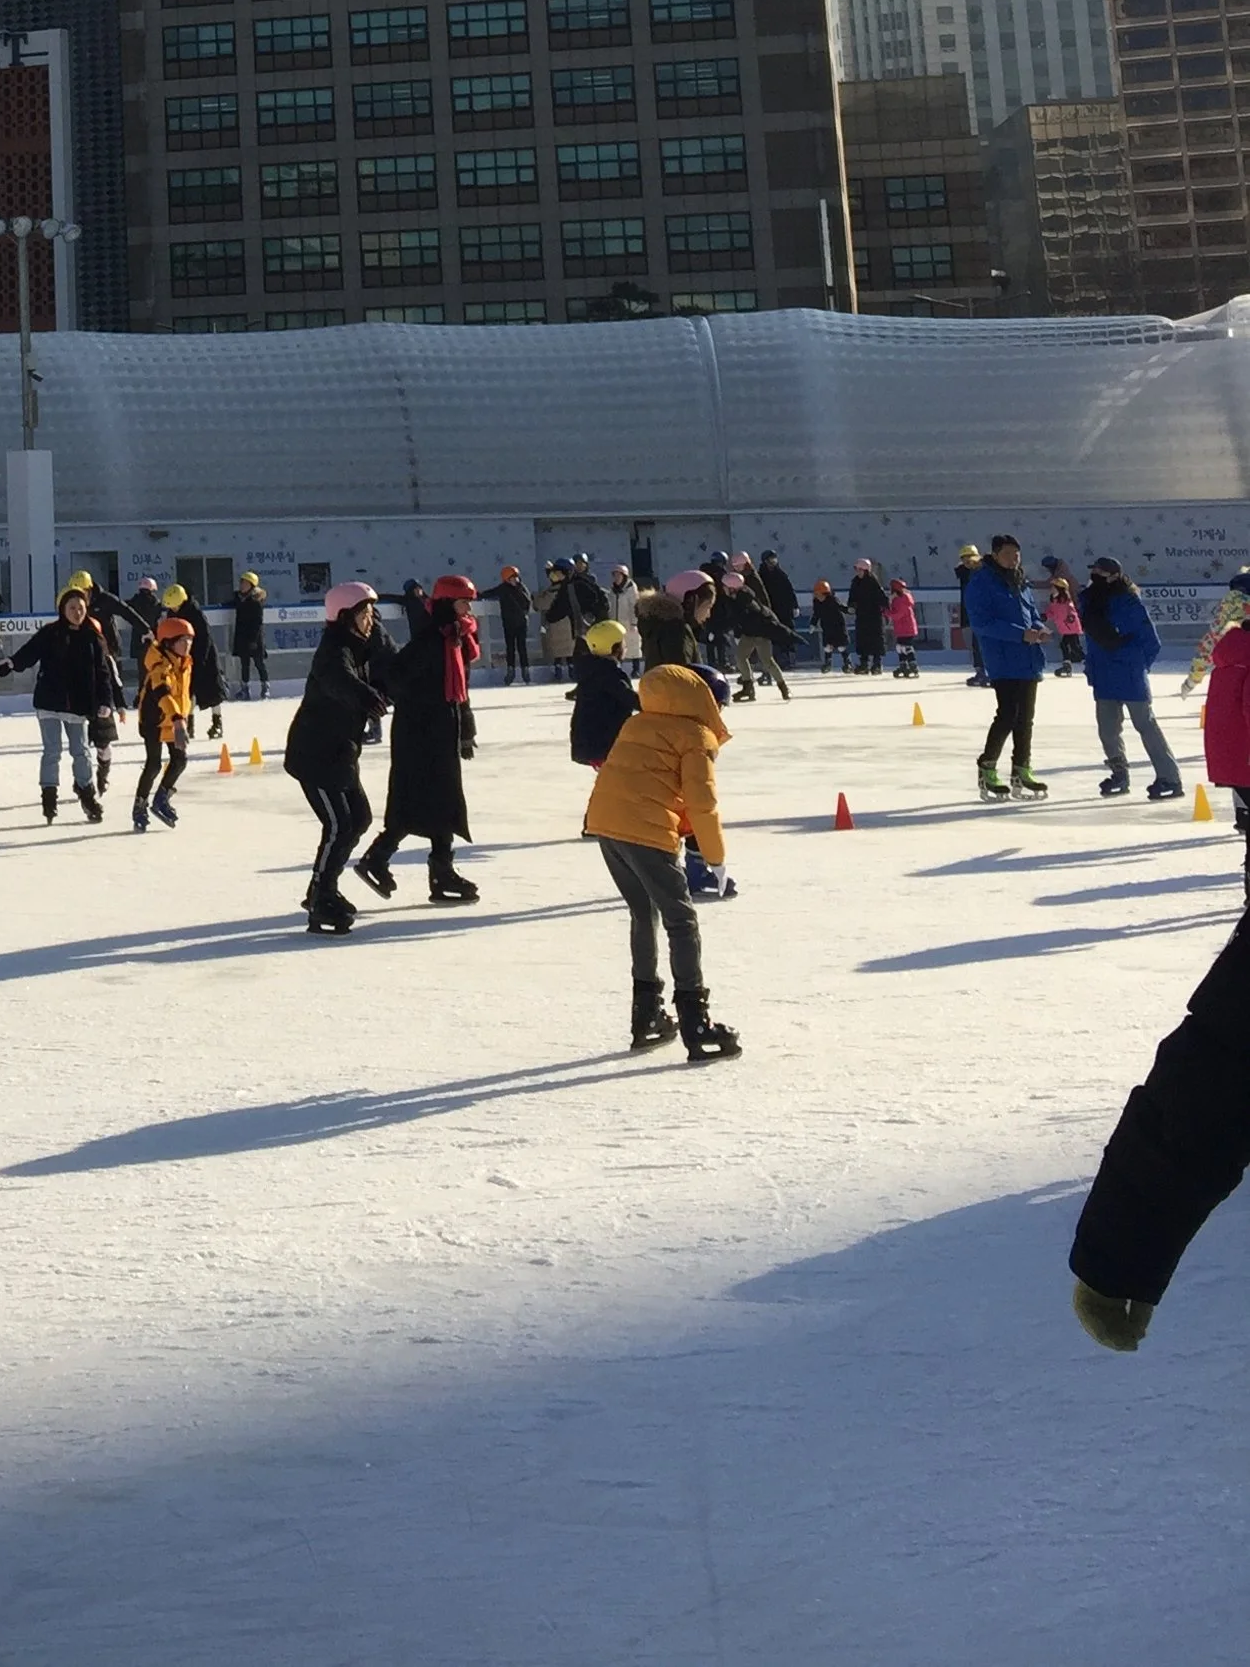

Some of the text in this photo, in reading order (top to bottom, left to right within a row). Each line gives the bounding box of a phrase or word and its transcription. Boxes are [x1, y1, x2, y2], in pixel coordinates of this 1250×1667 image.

[1165, 546, 1249, 557] Machine room
[126, 571, 138, 581] DJ
